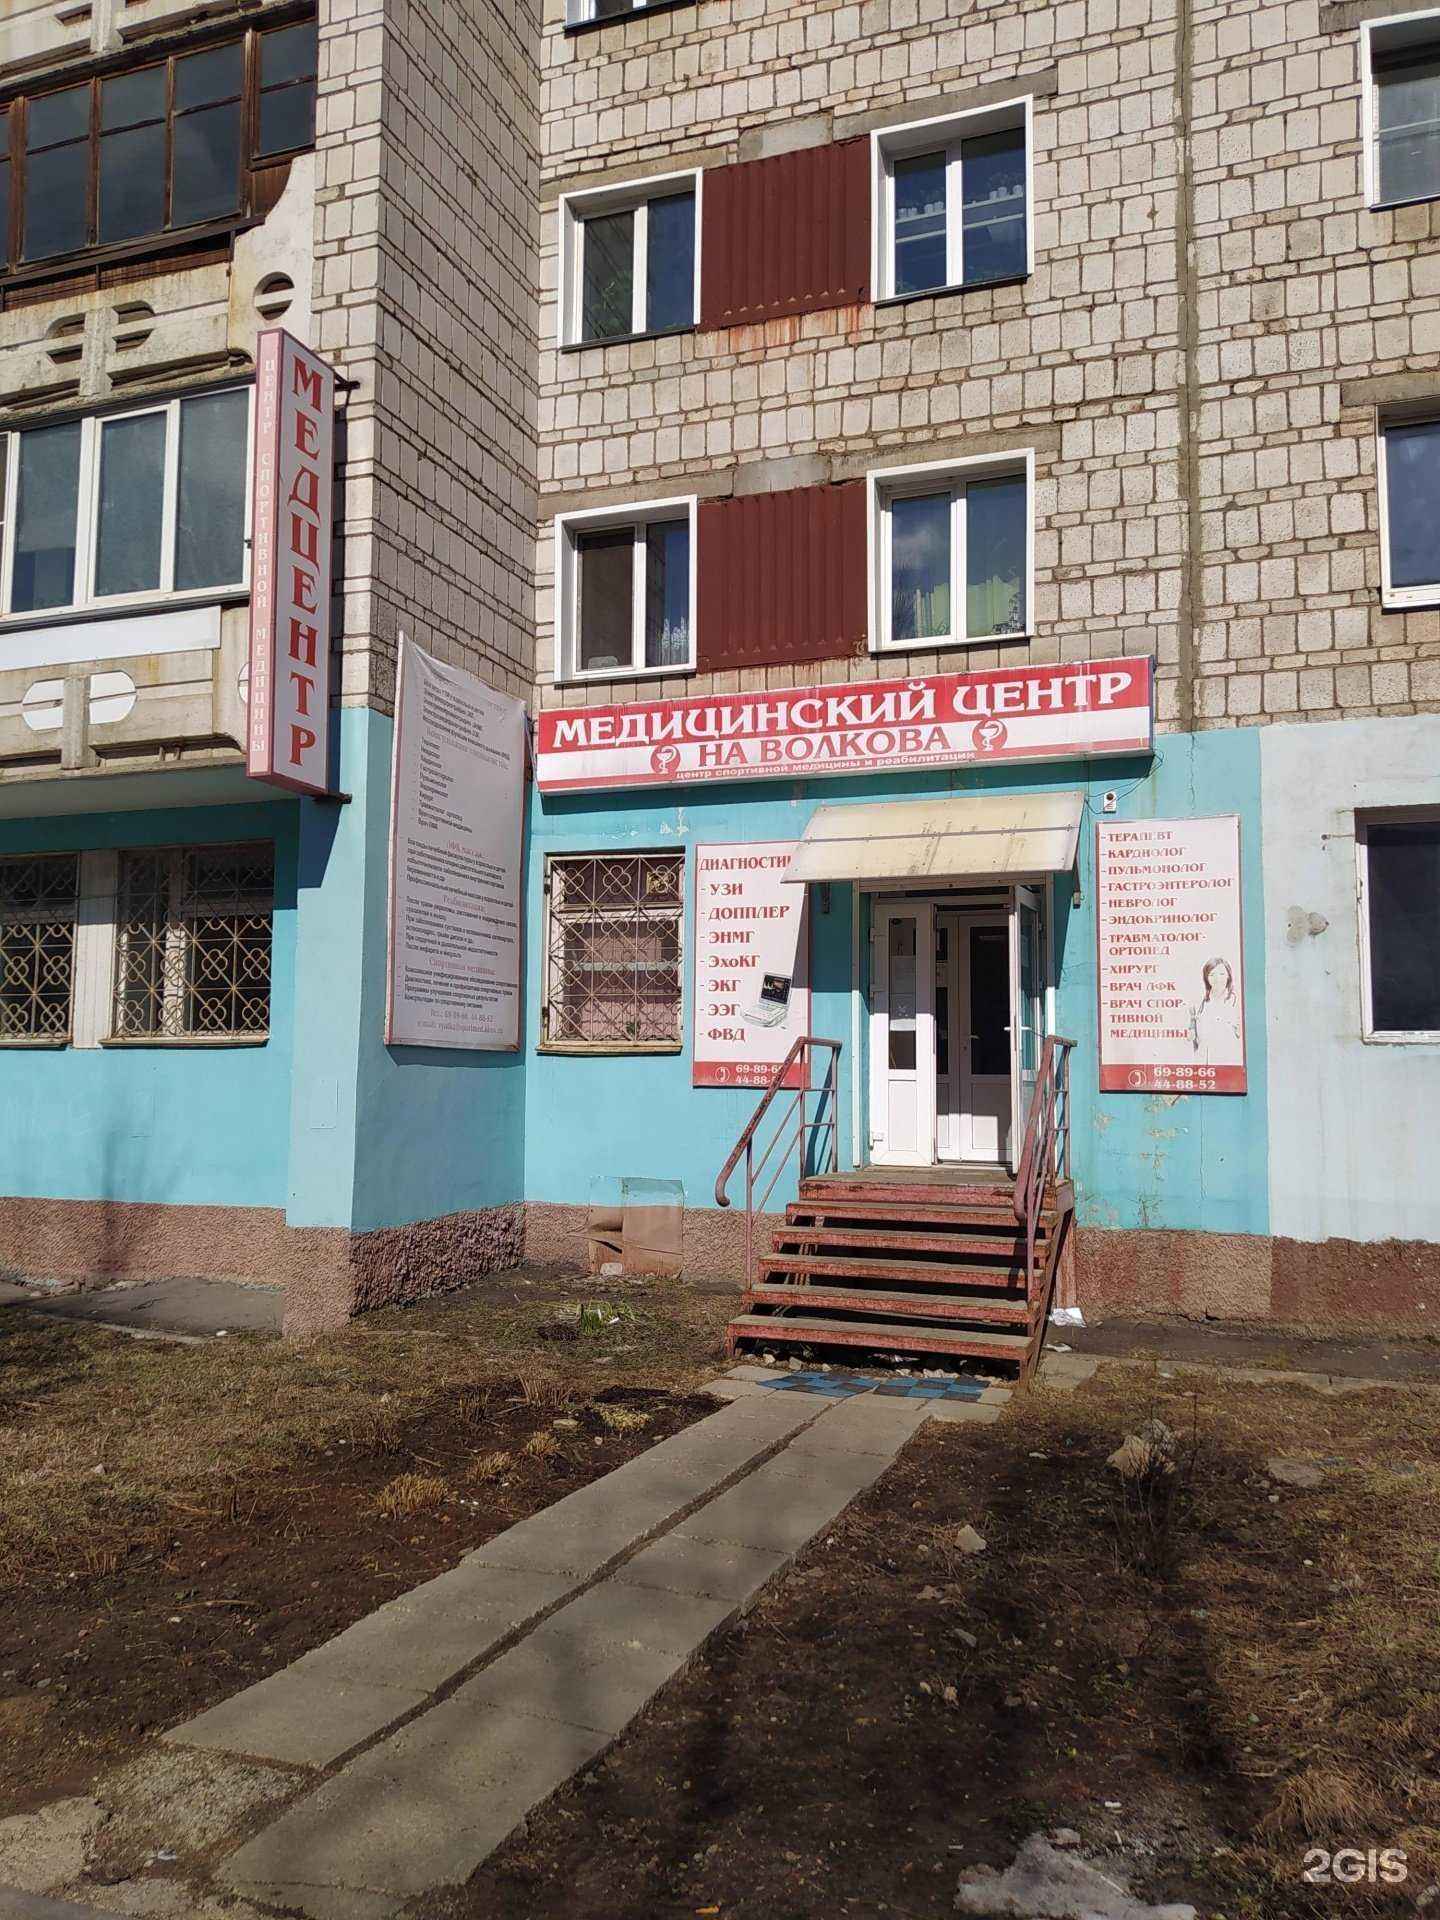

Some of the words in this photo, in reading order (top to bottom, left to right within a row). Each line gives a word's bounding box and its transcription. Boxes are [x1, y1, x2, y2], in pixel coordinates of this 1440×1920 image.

[286, 354, 324, 767] МЕДЦЕНТР
[552, 680, 936, 748] МЕДИЦИНСКИЙ
[952, 671, 1133, 717] ЦЕНТР
[698, 742, 748, 767] НА
[760, 726, 952, 762] ВОЛКОВА
[676, 767, 712, 780] центр
[715, 763, 790, 778] спортивной
[793, 759, 861, 772] медицины
[864, 758, 874, 767] и
[876, 751, 977, 767] реабилитации
[1108, 847, 1186, 859] КАРДИОЛОГ
[699, 854, 791, 872] ДИАГНОСТИ
[1108, 862, 1208, 876] ПУЛЬМОНОЛОГ
[708, 882, 744, 896] УЗИ
[708, 905, 791, 921] ДОППЛЕР
[708, 931, 755, 944] ЭНМГ
[708, 955, 760, 968] ЭхоКГ
[1109, 964, 1159, 974] ХИРУРГ
[708, 979, 742, 992] ЭКГ
[1109, 982, 1142, 992] ВРАЧ
[707, 1003, 742, 1016] ЭЭГ
[1109, 999, 1142, 1009] ВРАЧ
[707, 1027, 746, 1042] ФВД
[1110, 1028, 1190, 1040] МЕДИЦИНЫ
[1153, 1066, 1216, 1077] 69-89-66
[1153, 1079, 1216, 1090] 44-88-52
